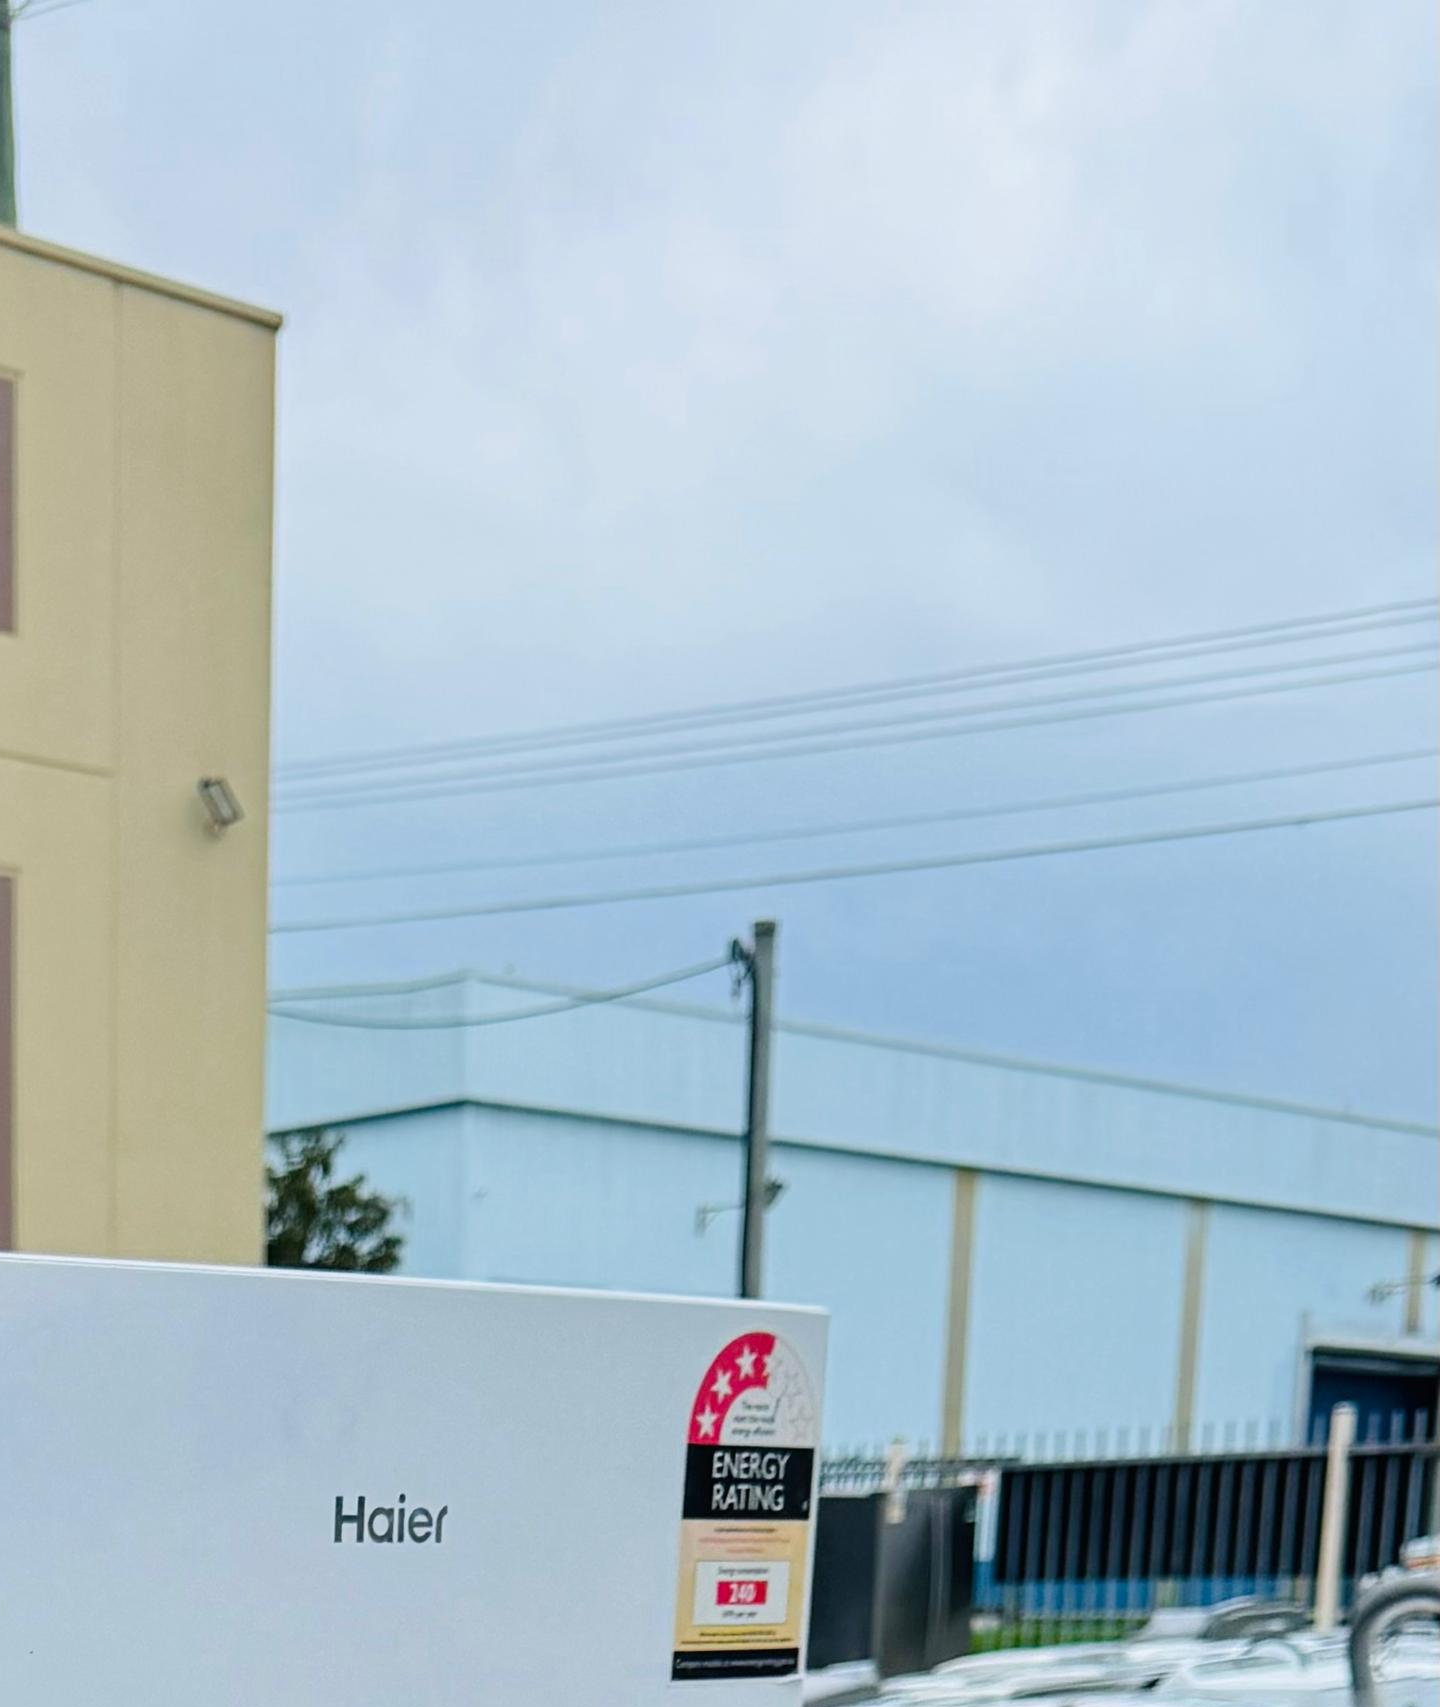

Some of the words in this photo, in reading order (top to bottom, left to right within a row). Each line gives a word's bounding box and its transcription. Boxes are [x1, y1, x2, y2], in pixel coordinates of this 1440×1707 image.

[711, 1451, 791, 1480] ENERGY
[711, 1483, 784, 1511] RATING
[334, 1493, 448, 1543] Haier
